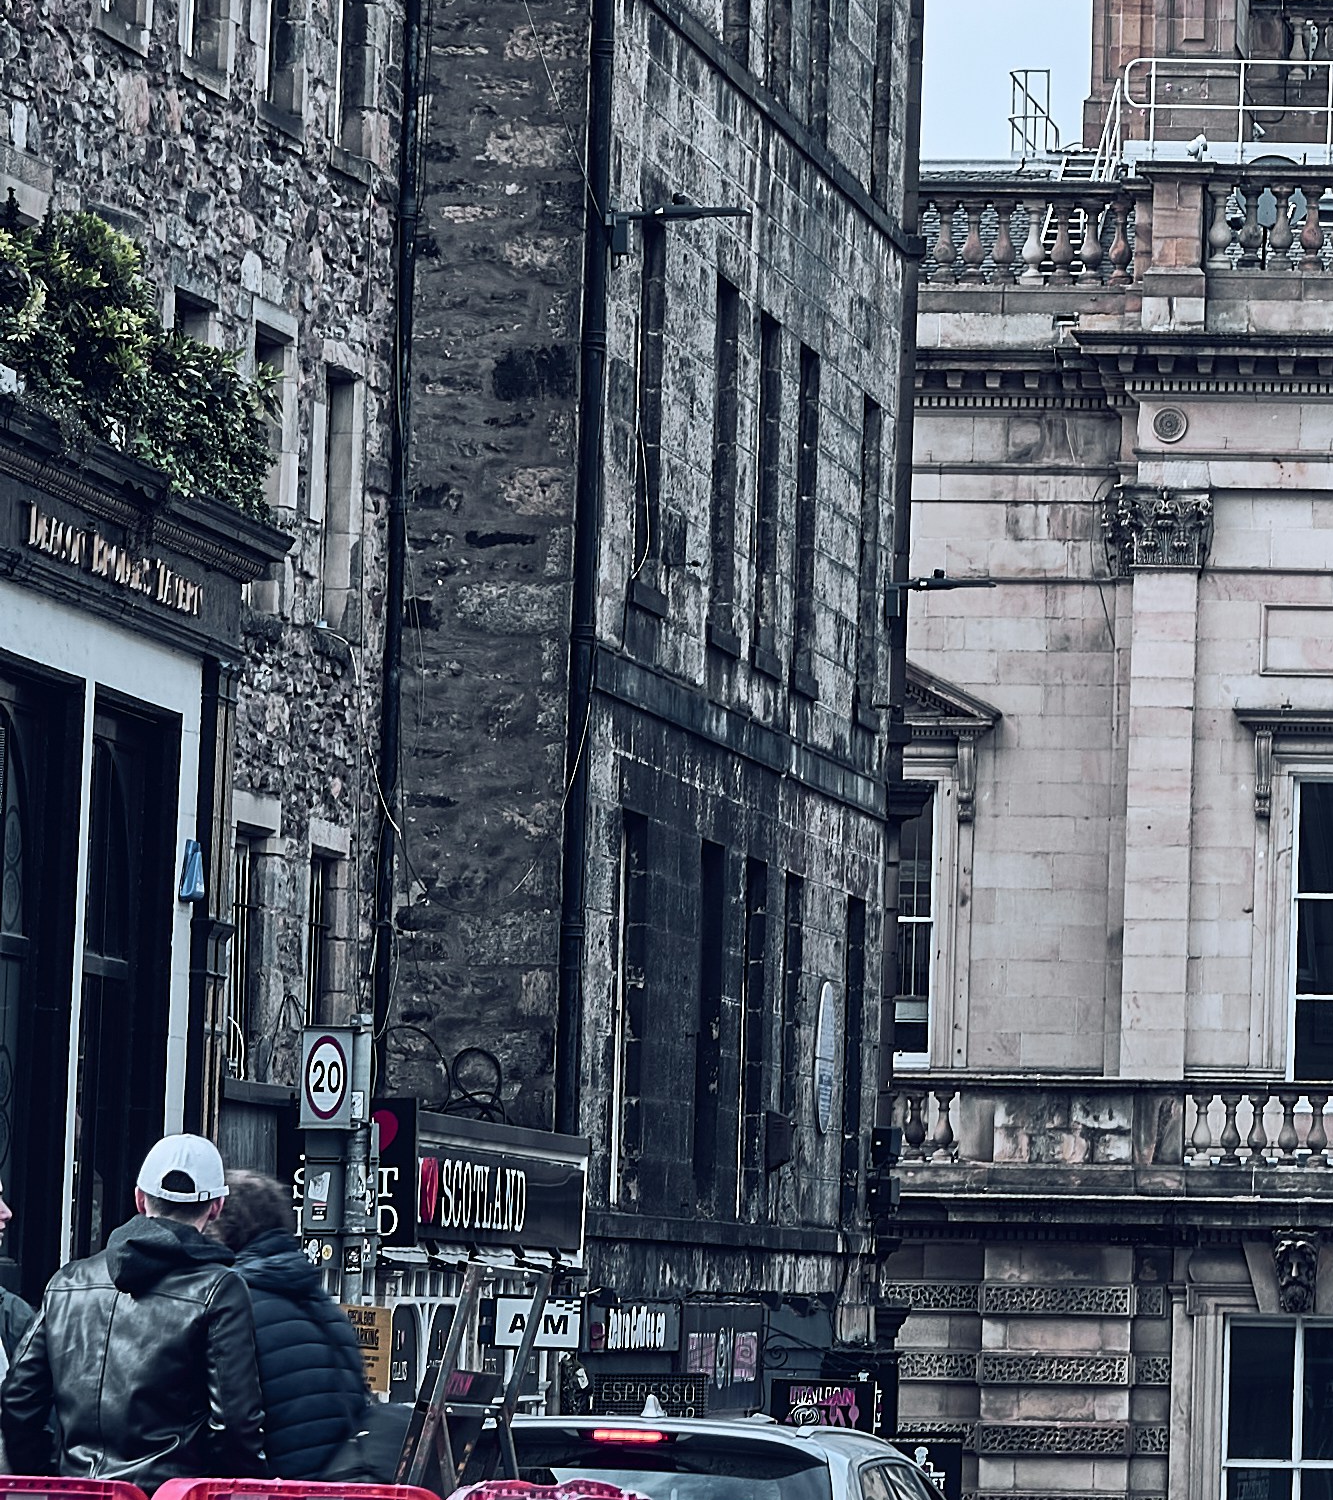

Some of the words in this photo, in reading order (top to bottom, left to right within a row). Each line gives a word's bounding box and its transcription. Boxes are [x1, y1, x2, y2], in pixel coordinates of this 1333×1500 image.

[312, 1060, 344, 1093] 20
[440, 1158, 528, 1233] SCOTLAND
[508, 1312, 569, 1335] AM
